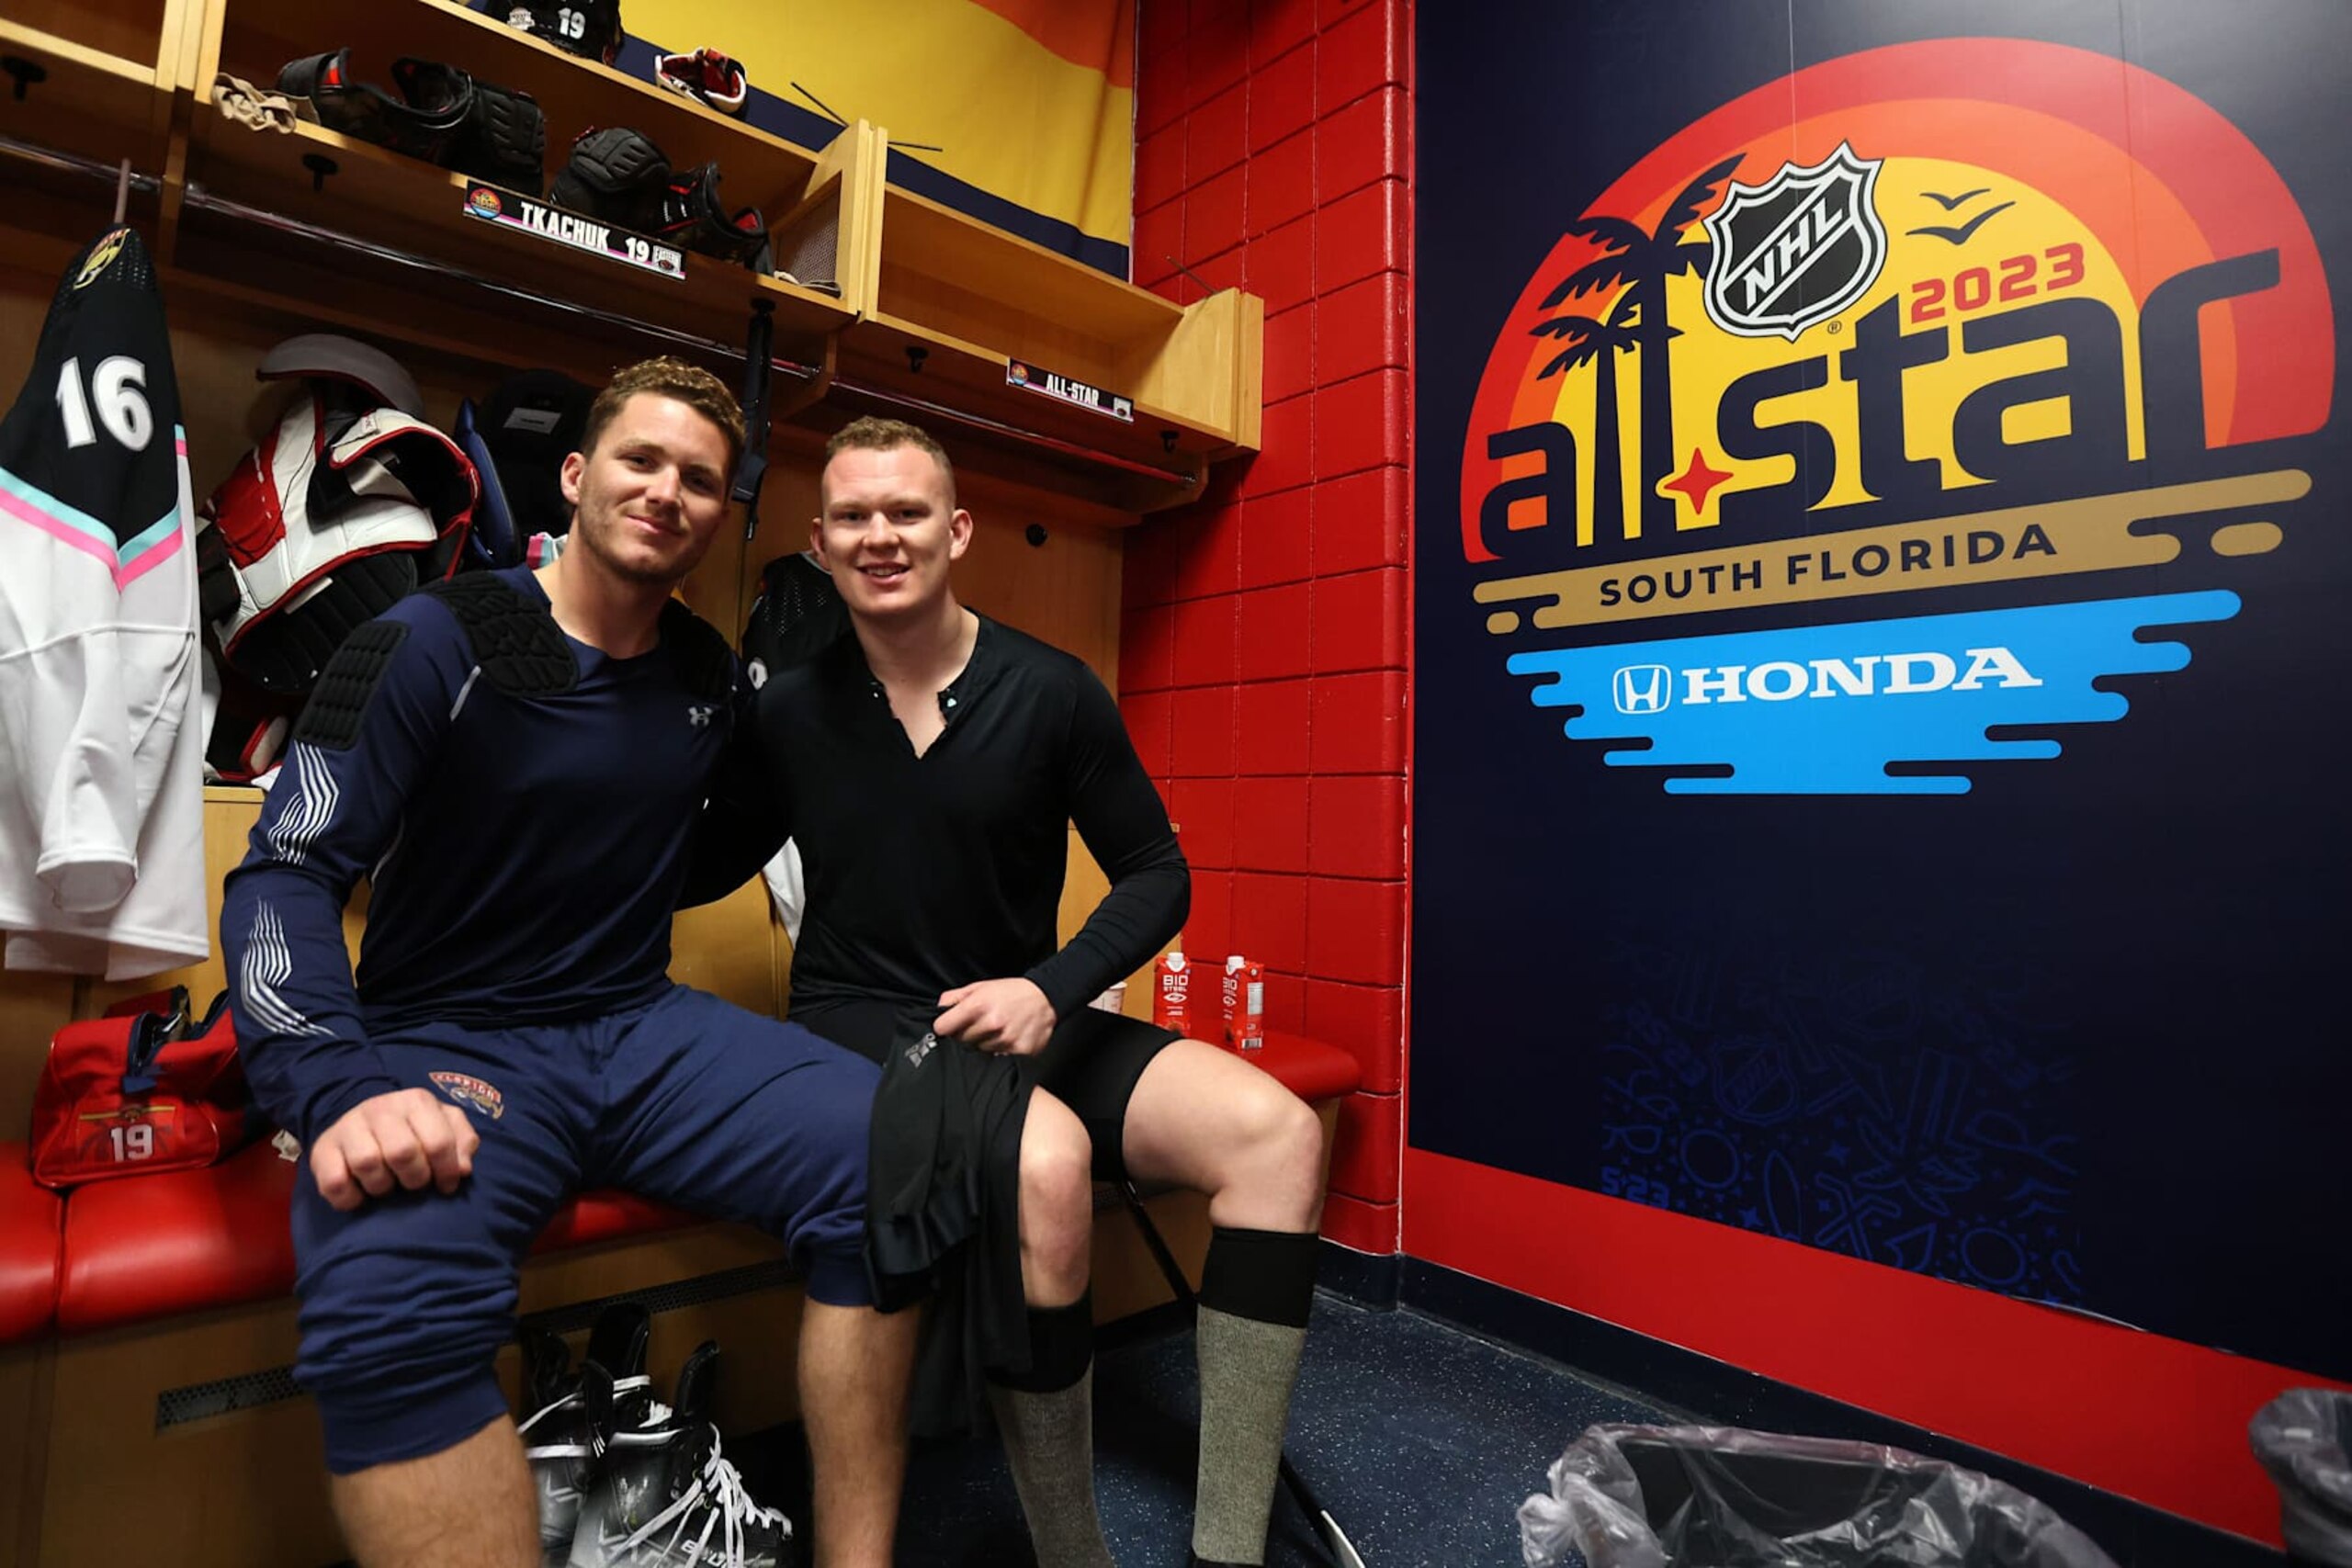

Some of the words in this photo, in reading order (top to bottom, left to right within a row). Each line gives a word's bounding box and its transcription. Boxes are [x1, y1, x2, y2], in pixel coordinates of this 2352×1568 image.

[557, 7, 586, 39] 19
[520, 201, 611, 252] TKACHUK
[625, 236, 650, 263] 19
[1743, 196, 1843, 309] NHL
[1910, 242, 2085, 324] 2023
[55, 355, 154, 452] 16
[1046, 373, 1100, 407] ALL-STAR
[1600, 559, 1762, 606] SOUTH
[1787, 523, 2057, 585] FLORIDA
[1681, 647, 2043, 705] HONDA
[1162, 975, 1189, 986] BIO
[110, 1123, 153, 1163] 19
